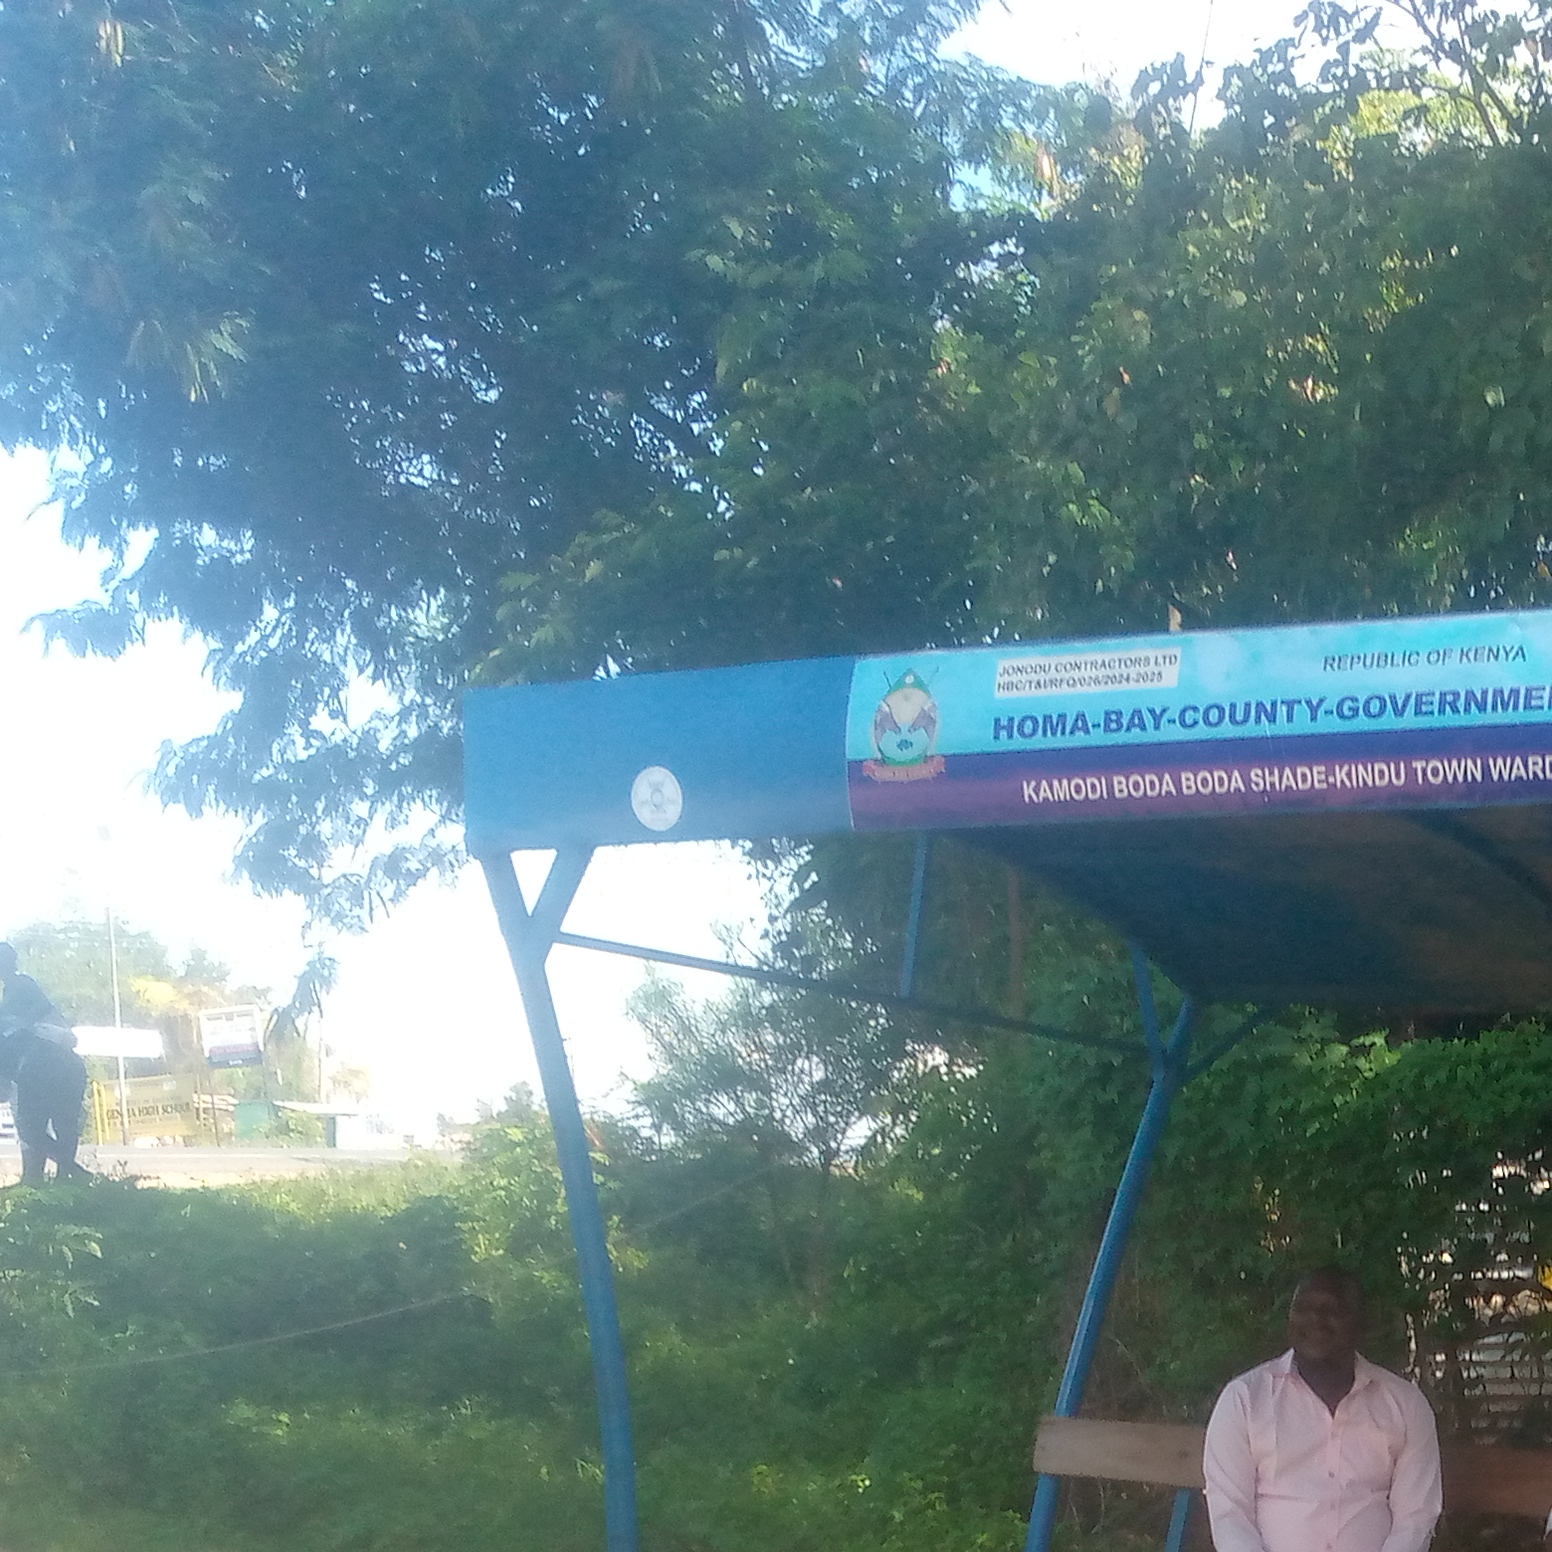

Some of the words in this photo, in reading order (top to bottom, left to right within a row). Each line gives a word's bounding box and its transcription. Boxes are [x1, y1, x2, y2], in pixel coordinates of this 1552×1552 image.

[999, 662, 1051, 678] JONODU
[1054, 655, 1151, 674] CONTRACTORS
[1154, 653, 1178, 668] LTD
[1322, 649, 1420, 673] REPUBLIC
[1425, 647, 1455, 667] OF
[1458, 643, 1528, 665] KENYA
[1022, 776, 1109, 804] KAMODI
[1113, 772, 1177, 799] BODA
[1180, 769, 1246, 796] BODA
[1250, 760, 1407, 793] SHADE-KINDU
[1411, 756, 1484, 785] TOWN
